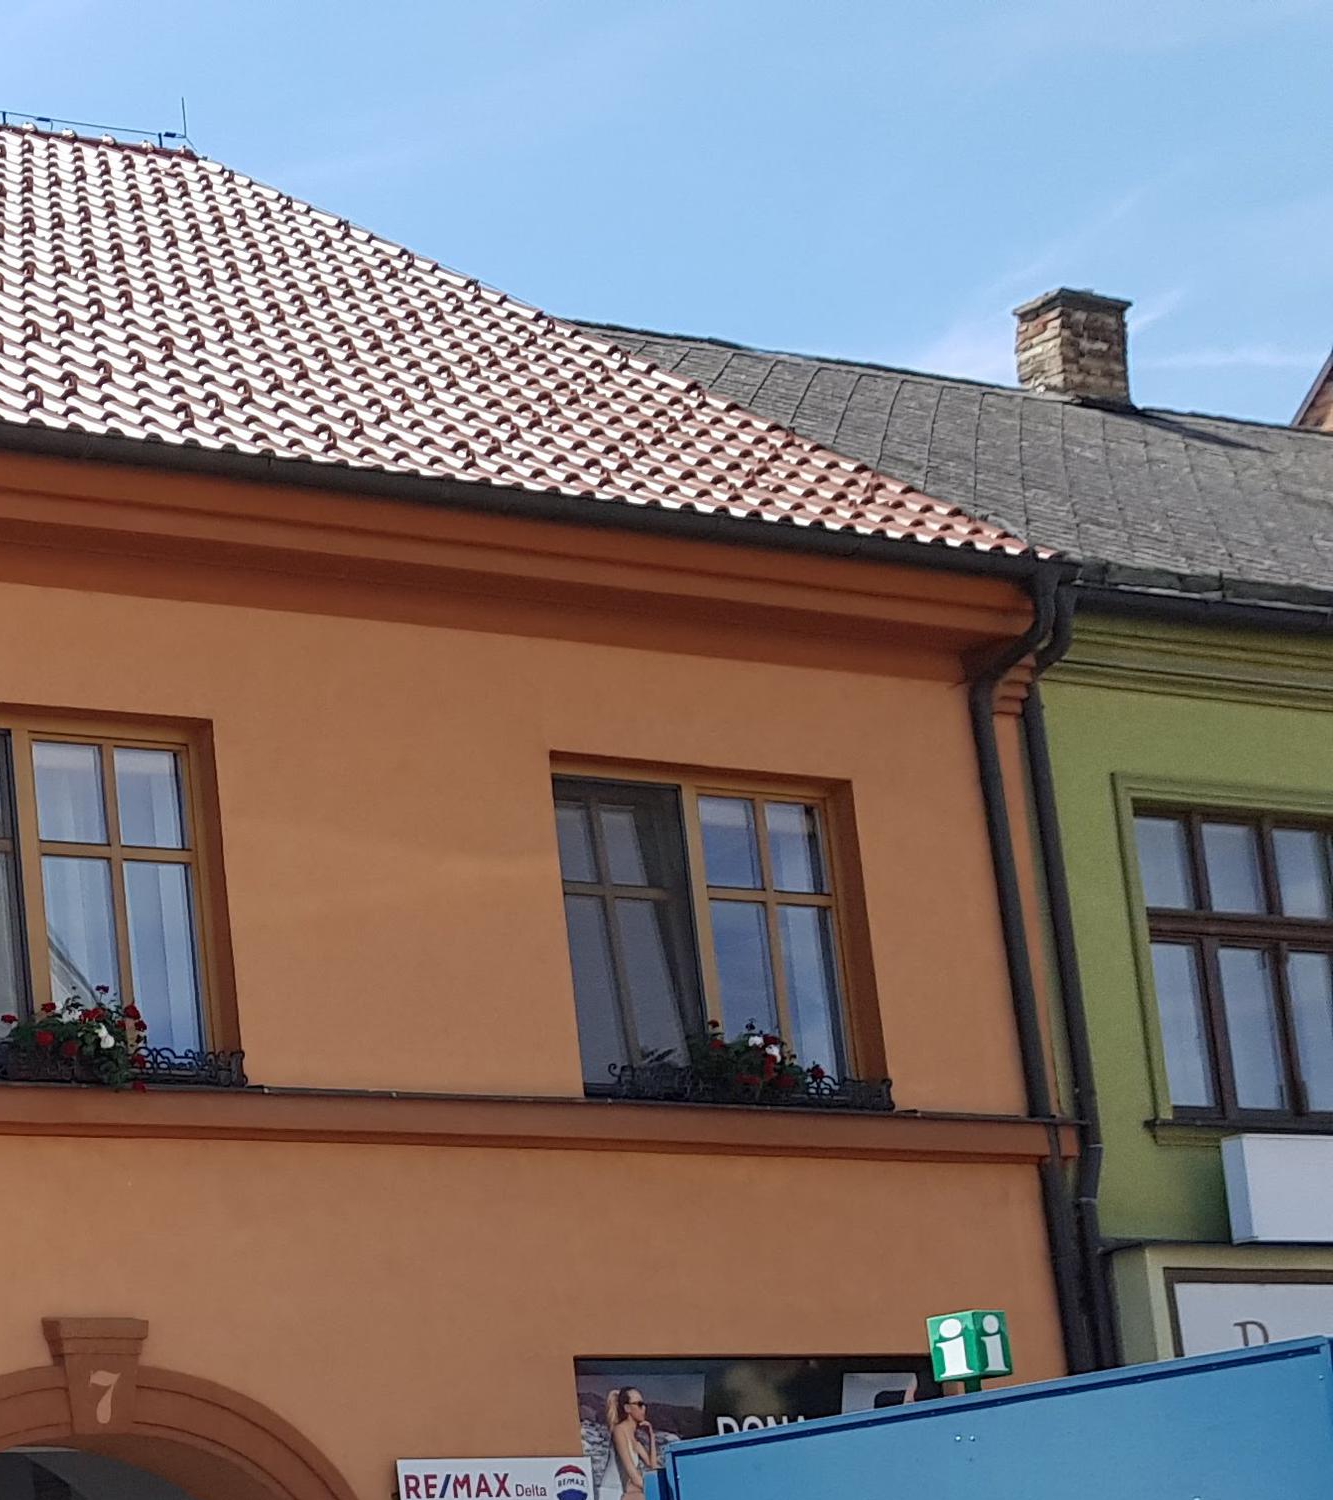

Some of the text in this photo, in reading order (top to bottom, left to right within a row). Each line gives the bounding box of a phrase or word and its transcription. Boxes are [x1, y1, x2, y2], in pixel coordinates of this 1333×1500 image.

[88, 1370, 121, 1424] 7
[403, 1473, 548, 1499] RE/MAX Delta
[557, 1477, 586, 1488] RE/MAX
